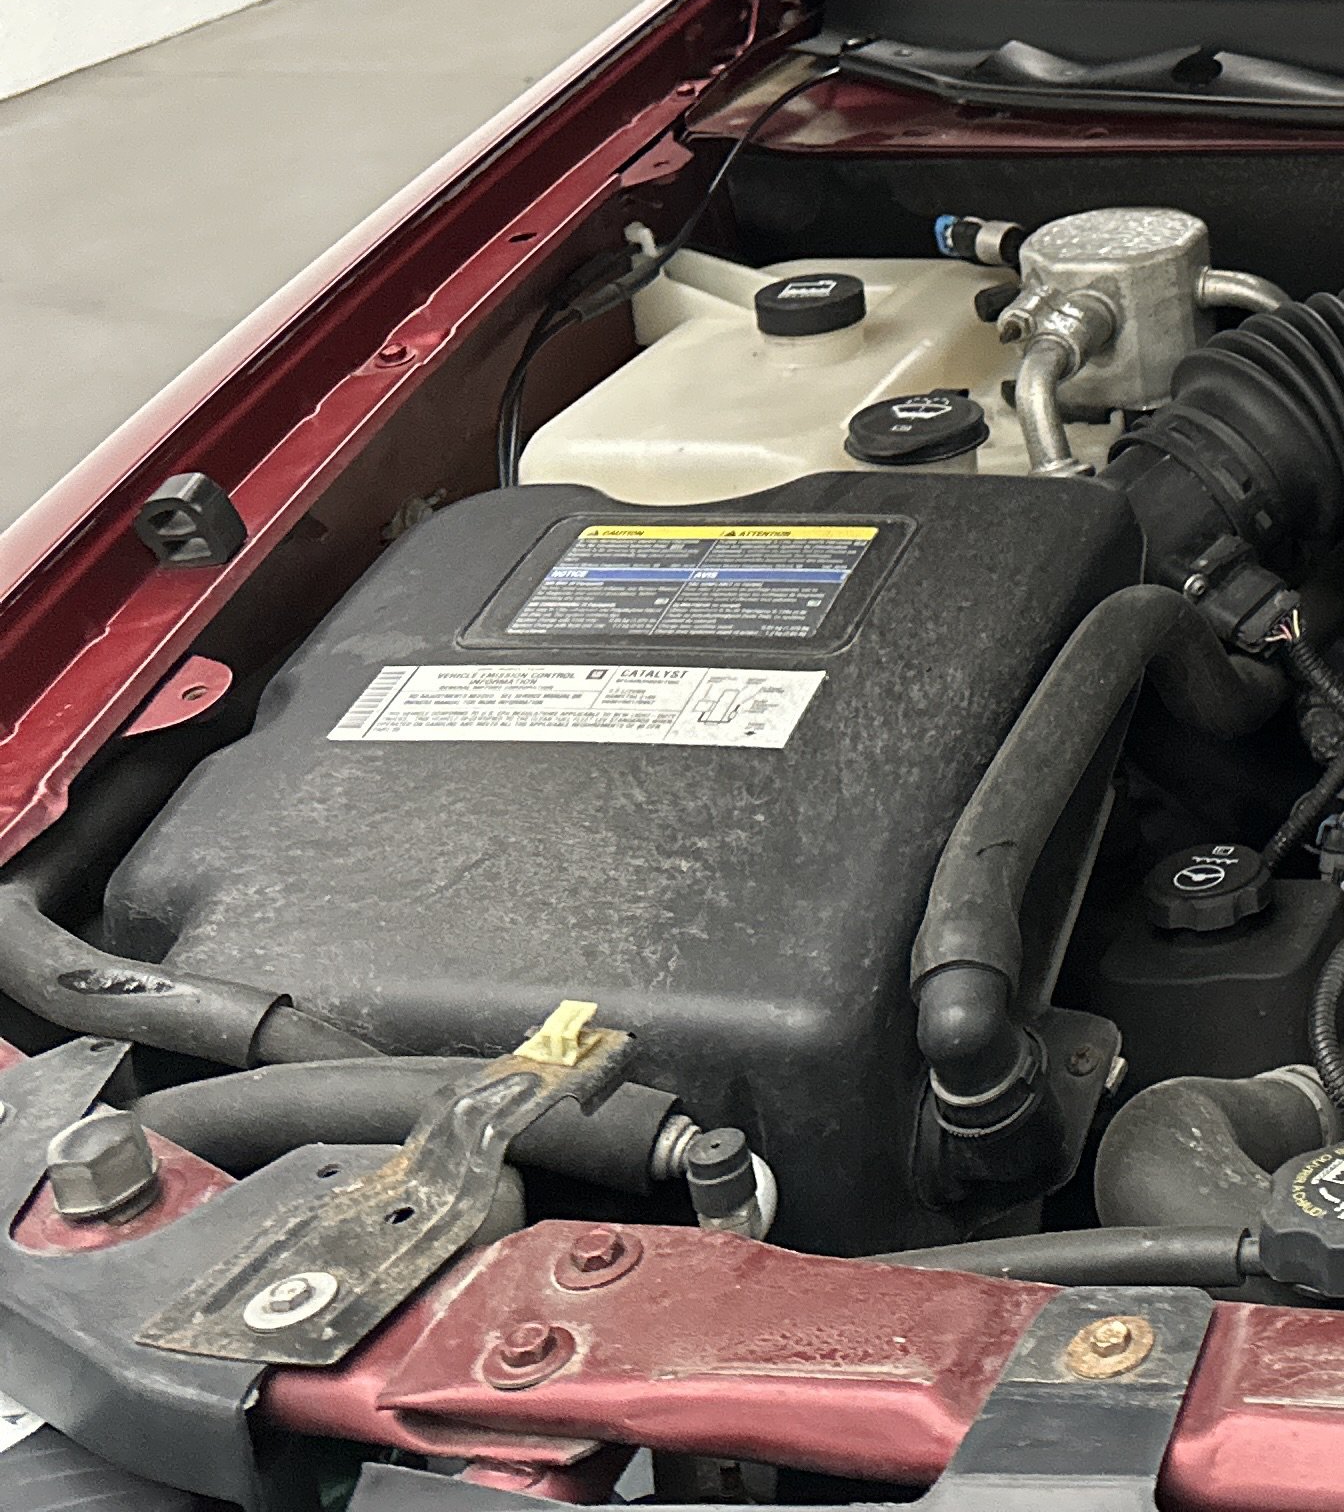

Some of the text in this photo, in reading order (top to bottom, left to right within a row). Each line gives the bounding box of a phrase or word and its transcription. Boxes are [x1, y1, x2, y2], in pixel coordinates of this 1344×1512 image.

[550, 570, 589, 578] NOTICE
[693, 571, 719, 579] AVIS
[437, 671, 478, 679] VEHICLE
[620, 669, 689, 680] CATALYST
[469, 678, 538, 686] INFORMATION
